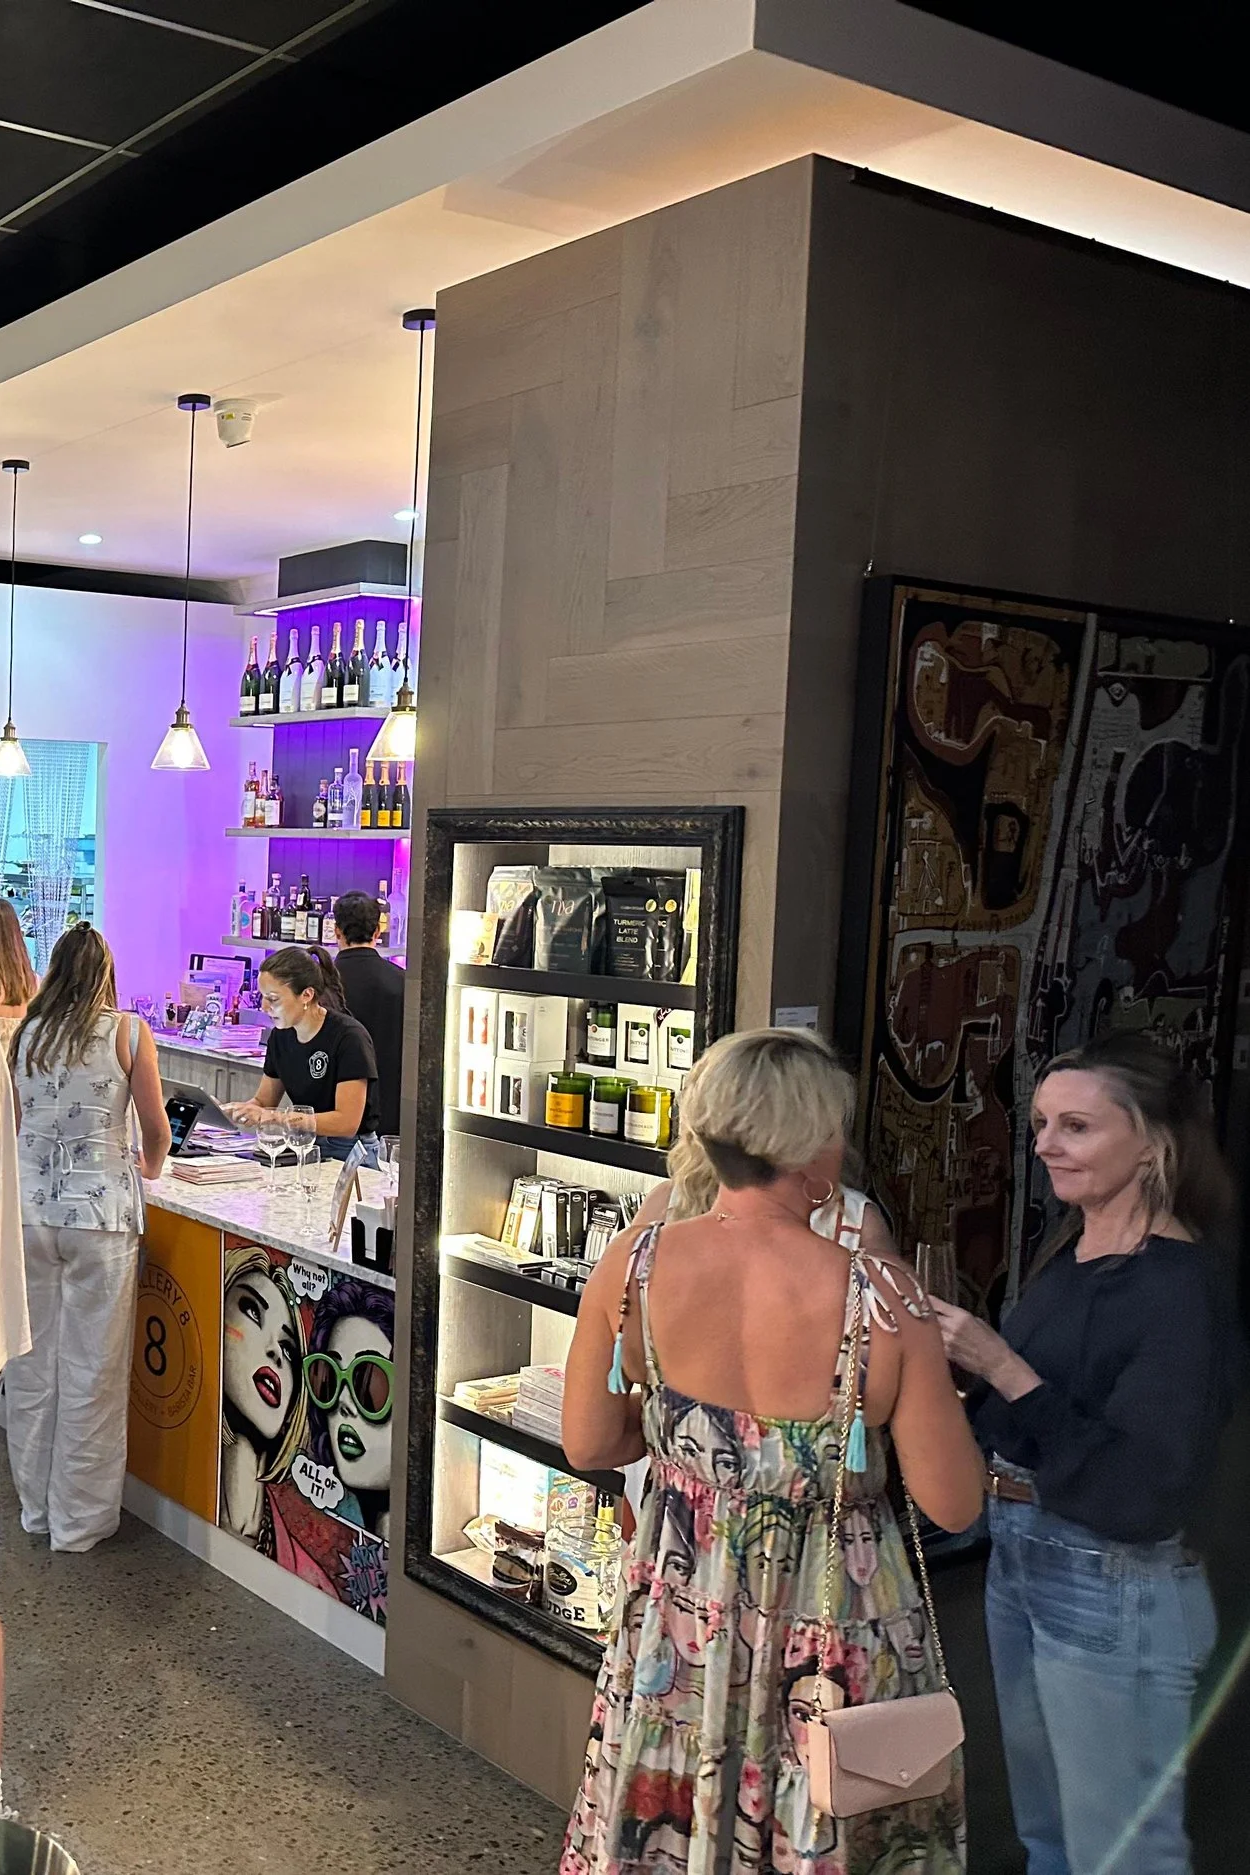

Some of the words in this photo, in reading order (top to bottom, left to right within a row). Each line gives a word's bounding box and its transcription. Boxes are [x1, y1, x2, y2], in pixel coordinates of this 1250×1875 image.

[613, 918, 646, 927] TURMERIC
[618, 927, 639, 935] LATTE
[315, 1059, 322, 1071] 8
[293, 1262, 311, 1281] Why
[312, 1272, 326, 1284] not
[138, 1270, 182, 1306] LLERY
[179, 1310, 191, 1326] 8
[302, 1280, 317, 1292] all?
[144, 1315, 167, 1377] 8
[299, 1462, 323, 1484] ALL
[324, 1477, 338, 1491] OF
[350, 1544, 380, 1574] ART
[348, 1568, 388, 1601] RULE
